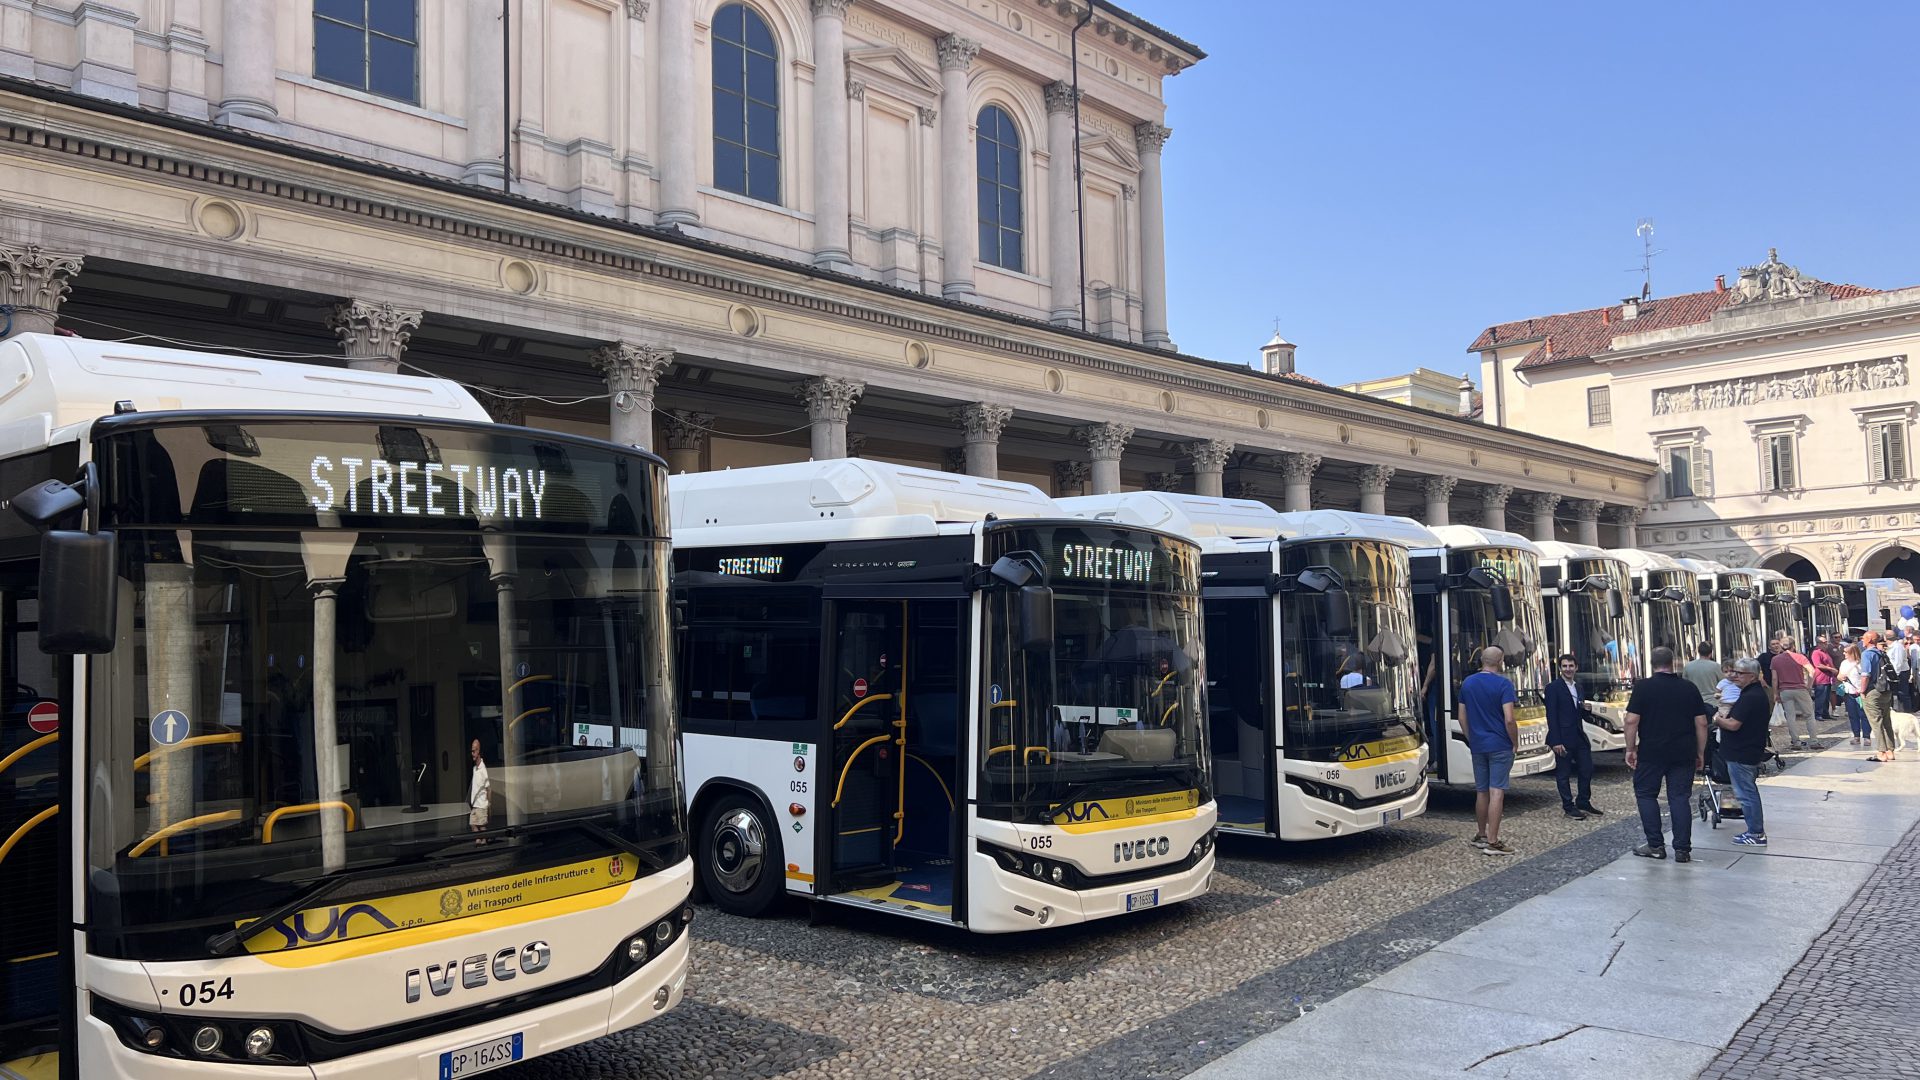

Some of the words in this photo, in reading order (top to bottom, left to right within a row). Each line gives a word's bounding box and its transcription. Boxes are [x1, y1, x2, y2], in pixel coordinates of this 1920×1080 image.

[310, 455, 546, 518] STREETWAY
[718, 556, 783, 575] STREETWAY
[1063, 544, 1153, 581] STREETWAY
[1326, 769, 1340, 780] 056
[1375, 769, 1406, 789] IVECO
[790, 780, 807, 793] 055
[1031, 836, 1052, 849] 055
[1114, 836, 1169, 863] IVECO
[467, 883, 510, 897] Ministero
[512, 878, 533, 889] delle
[535, 868, 588, 884] Infrastrutture
[467, 901, 482, 911] dei
[484, 893, 522, 908] Trasporti
[406, 941, 550, 1003] IVECO
[179, 977, 235, 1006] 054
